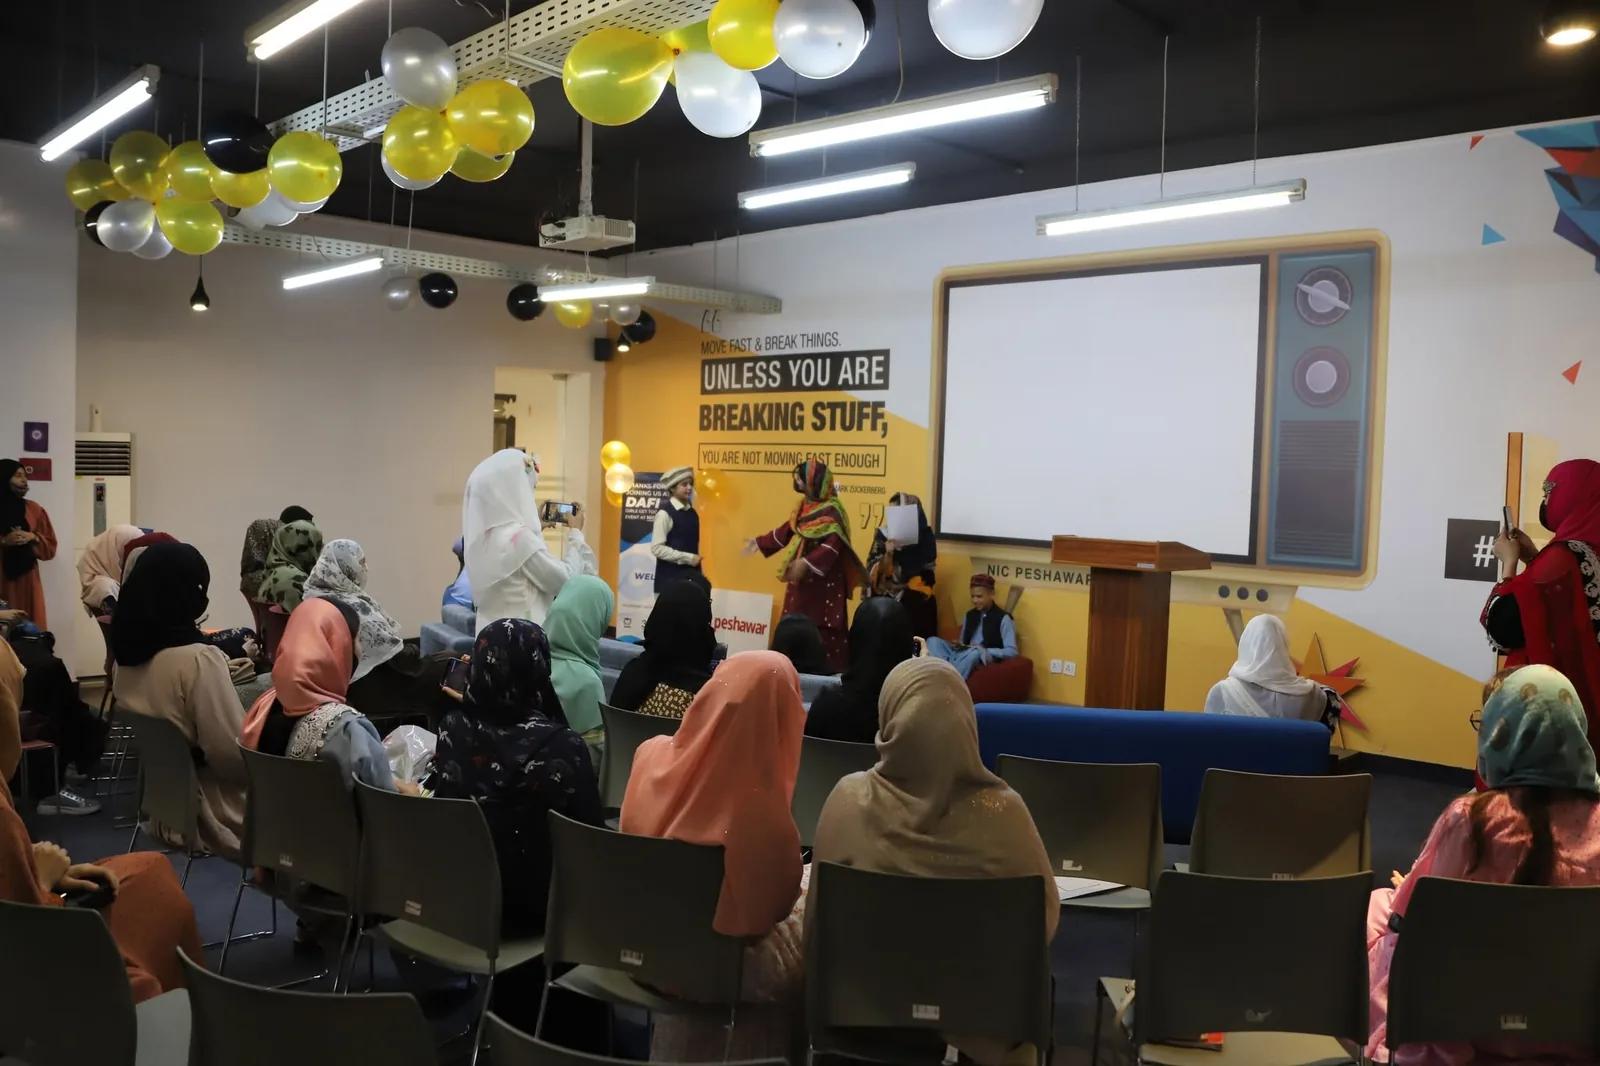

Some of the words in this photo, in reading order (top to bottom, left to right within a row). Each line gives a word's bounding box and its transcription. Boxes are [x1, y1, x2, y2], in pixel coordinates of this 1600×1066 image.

[701, 340, 727, 355] MOVE
[729, 337, 752, 352] FAST
[754, 337, 762, 352] &
[764, 333, 798, 351] BREAK
[799, 331, 842, 348] THINGS.
[704, 360, 781, 390] UNLESS
[788, 358, 831, 387] YOU
[837, 355, 885, 385] ARE
[699, 401, 805, 432] BREAKING
[811, 400, 888, 439] STUFF,
[702, 450, 720, 464] YOU
[721, 450, 740, 465] ARE
[742, 450, 762, 465] NOT
[763, 451, 803, 466] MOVING
[834, 452, 880, 468] ENOUGH
[625, 496, 661, 509] DAFI
[987, 564, 1009, 577] NIC
[714, 616, 768, 635] peshawar
